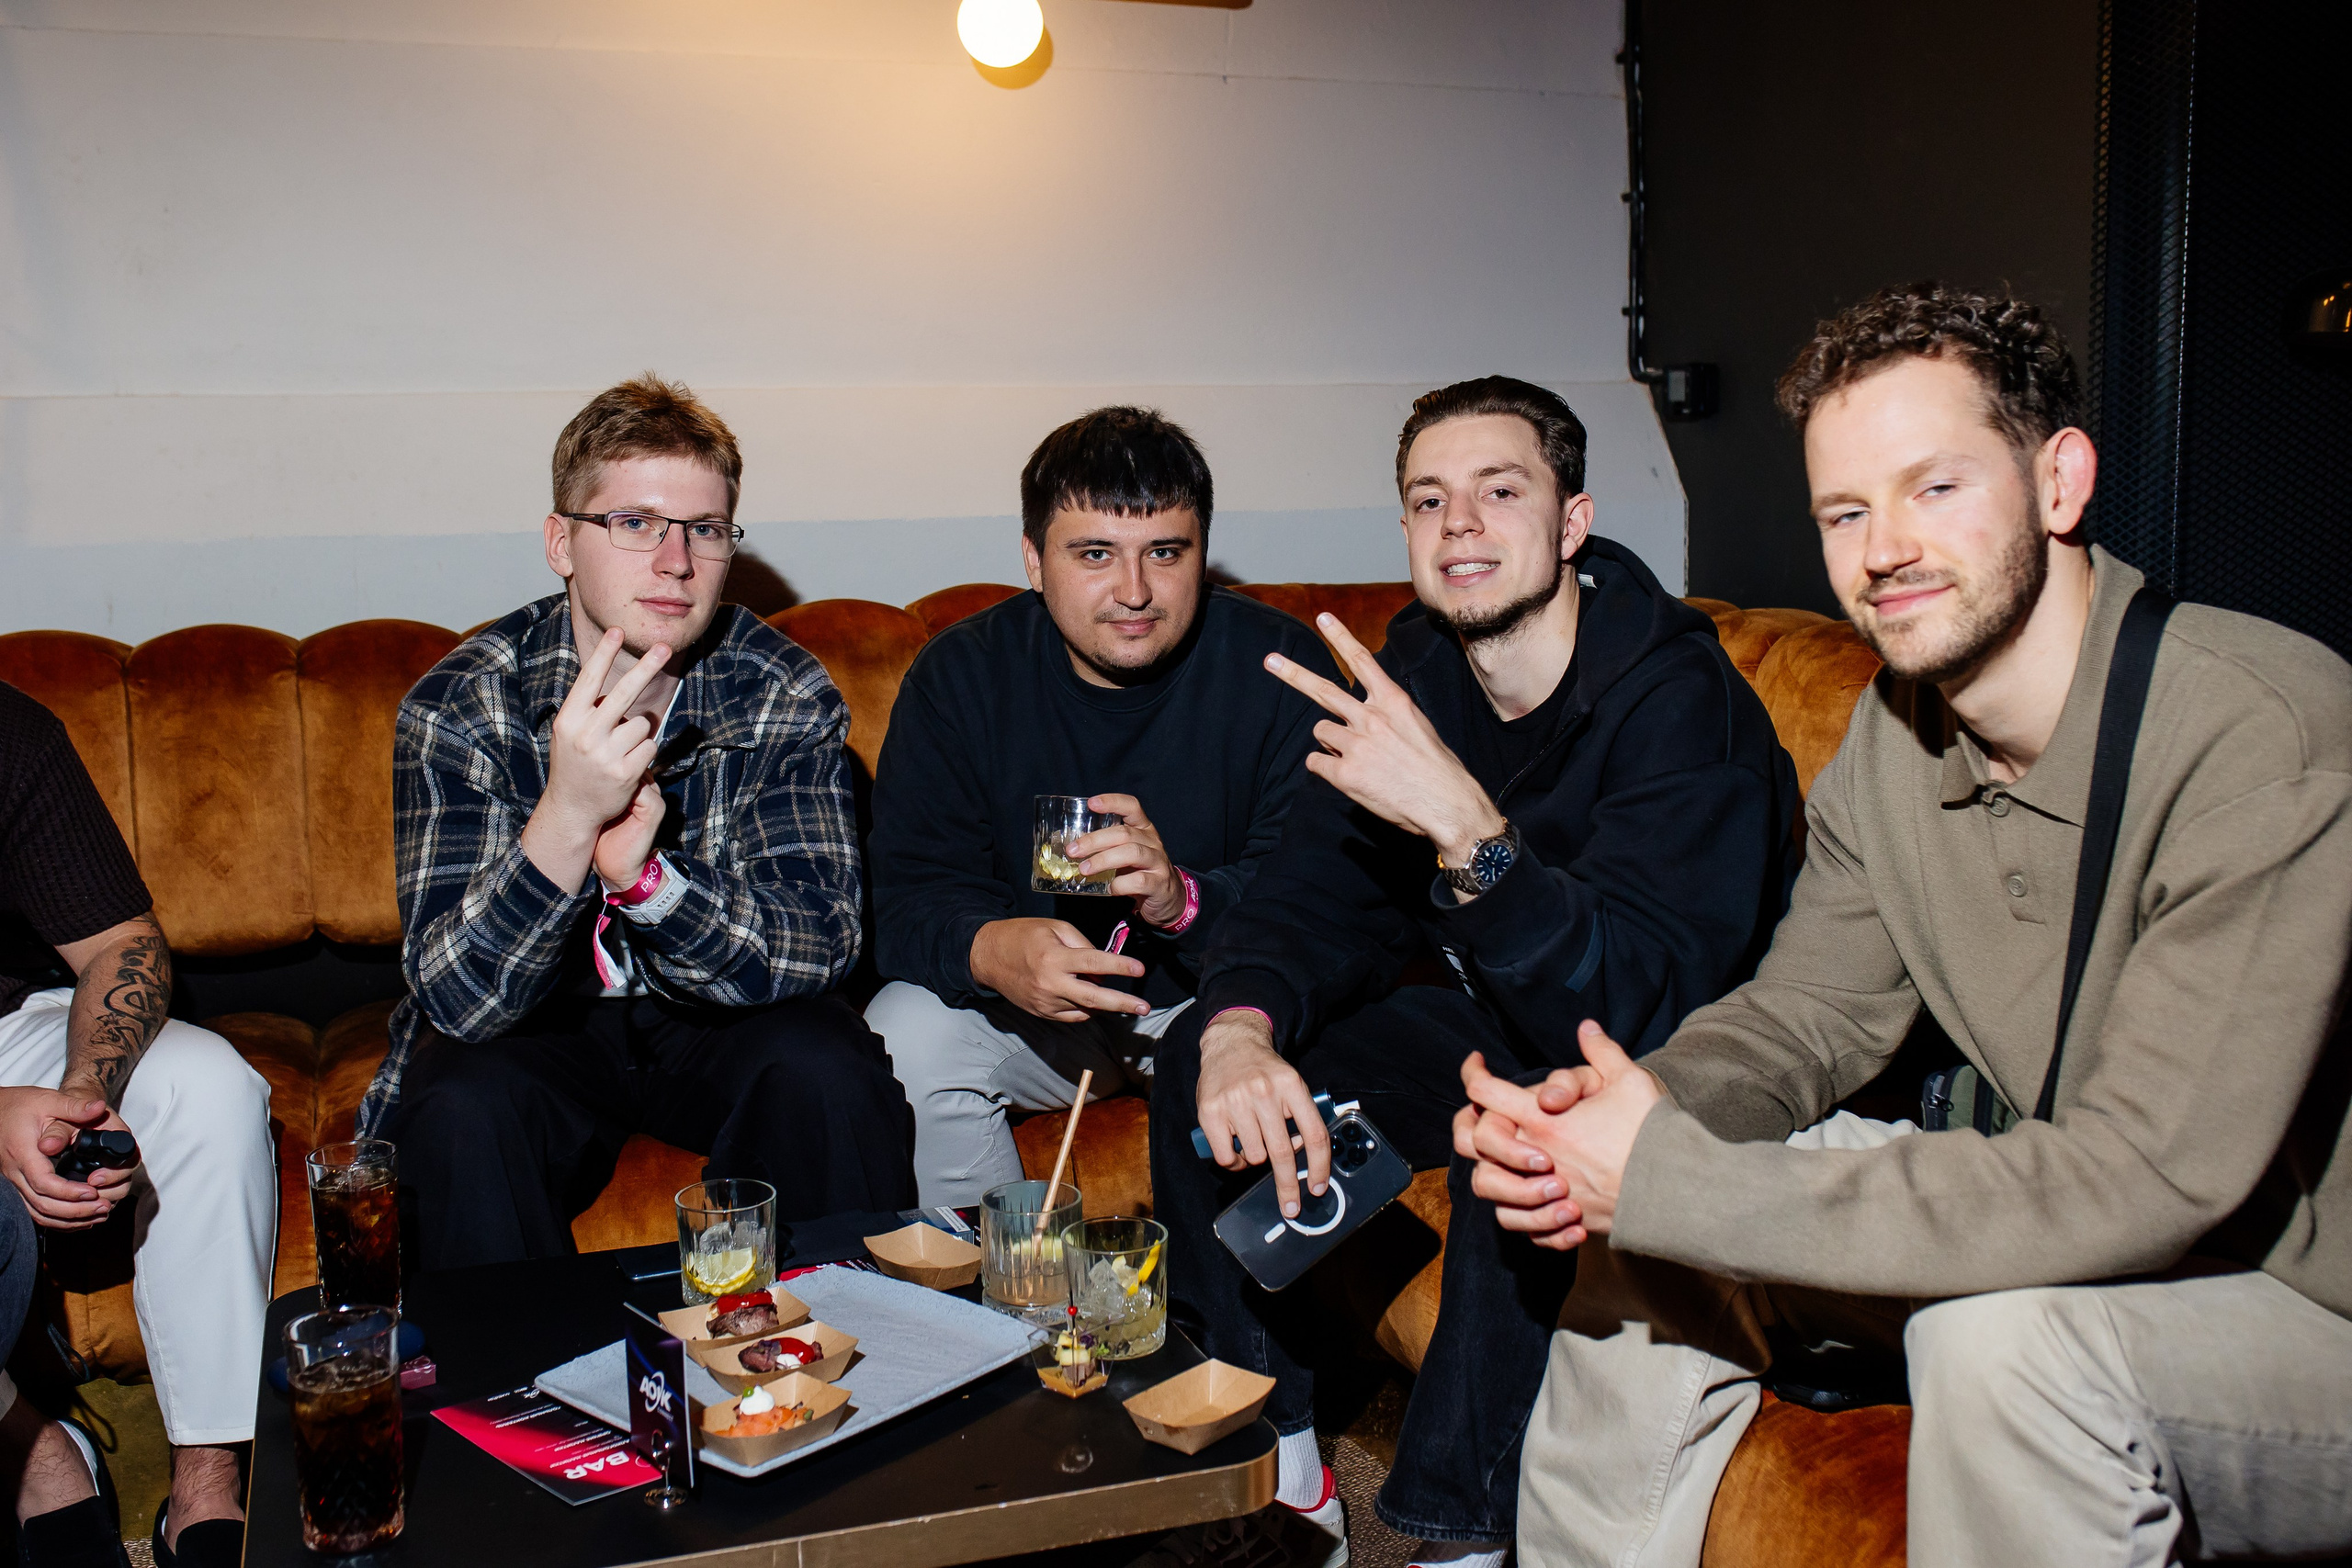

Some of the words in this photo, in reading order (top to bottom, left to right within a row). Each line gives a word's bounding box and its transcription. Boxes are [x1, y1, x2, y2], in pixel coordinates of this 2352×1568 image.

[640, 863, 658, 893] PRO
[1175, 908, 1194, 931] PRO
[563, 1450, 629, 1479] BAR
